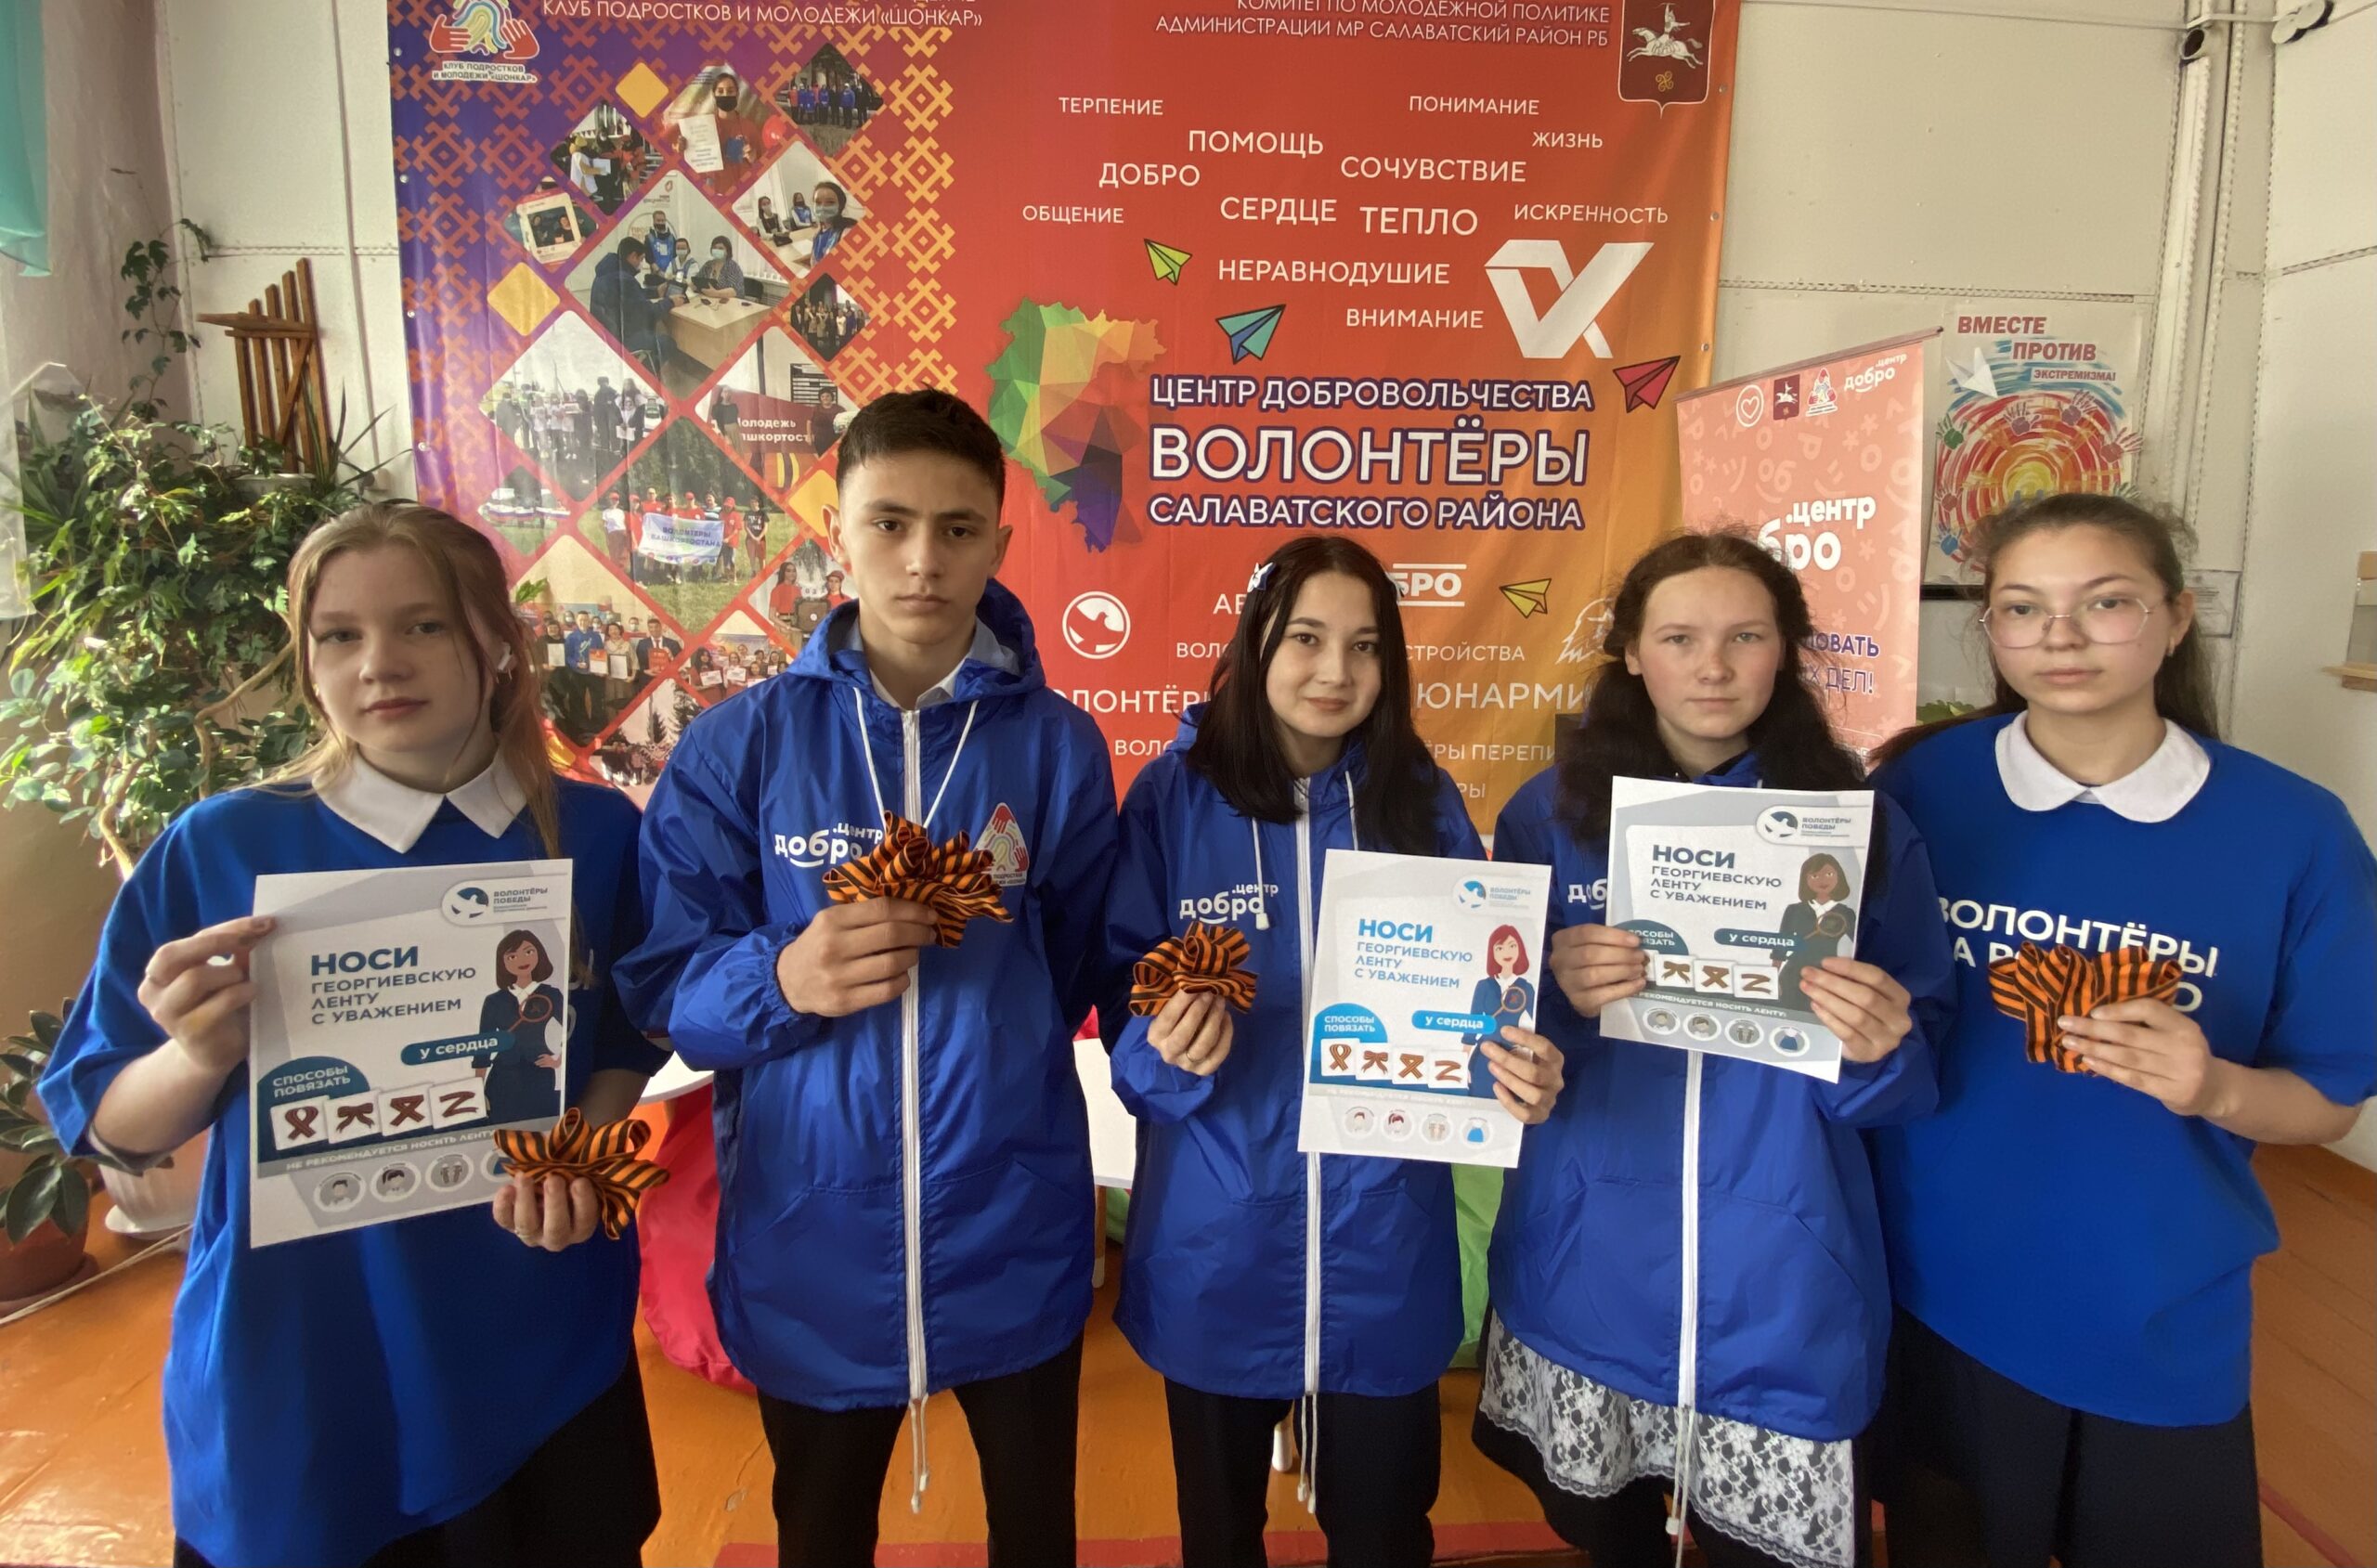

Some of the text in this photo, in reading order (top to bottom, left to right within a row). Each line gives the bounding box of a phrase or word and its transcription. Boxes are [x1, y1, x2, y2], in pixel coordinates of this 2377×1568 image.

[543, 0, 982, 26] КЛУБ ПОДРОСТКОВ И МОЛОДЕЖИ «ШОНКАР»
[1513, 4, 1610, 23] ПОЛИТИКЕ
[1155, 16, 1608, 46] АДМИНИСТРАЦИИ МР САЛАВАТСКИЙ РАЙОН РБ
[467, 63, 524, 72] ПОДРОСТКОВ
[1059, 97, 1163, 115] ТЕРПЕНИЕ
[1409, 96, 1539, 115] ПОНИМАНИЕ
[1188, 130, 1324, 159] ПОМОЩЬ
[1532, 131, 1604, 149] ЖИЗНЬ
[1098, 162, 1201, 188] ДОБРО
[1340, 156, 1527, 183] СОЧУВСТВИЕ
[1022, 205, 1124, 225] ОБЩЕНИЕ
[1219, 196, 1338, 226] СЕРДЦЕ
[1358, 205, 1479, 237] ТЕПЛО
[1513, 203, 1669, 225] ИСКРЕННОСТЬ
[1218, 259, 1450, 287] НЕРАВНОДУШИЕ
[1346, 308, 1485, 329] ВНИМАНИЕ
[1957, 315, 2047, 334] ВМЕСТЕ
[2012, 342, 2098, 361] ПРОТИВ
[1844, 366, 1896, 392] добро
[2033, 369, 2116, 382] ЭКСТРЕМИЗМА!
[1153, 378, 1593, 409] ЦЕНТР ДОБРОВОЛЬЧЕСТВА
[737, 417, 796, 430] олодежь
[1152, 417, 1587, 483] ВОЛОНТЁРЫ
[1150, 493, 1582, 527] САЛАВАТСКОГО РАЙОНА
[774, 829, 863, 864] добро
[1652, 845, 1735, 869] НОСИ
[1650, 878, 1701, 892] ЛЕНТУ
[1651, 865, 1783, 888] ГЕОРГИЕВСКУЮ
[1179, 890, 1262, 921] добро
[1650, 889, 1768, 911] С УВАЖЕНИЕМ
[1358, 918, 1434, 943] НОСИ
[1742, 933, 1795, 947] сердца
[311, 946, 419, 976] НОСИ
[1356, 956, 1402, 969] ЛЕНТУ
[1357, 941, 1473, 963] ГЕОРГИЕВСКУЮ
[311, 967, 476, 994] ГЕОРГИЕВСКУЮ
[1355, 968, 1460, 989] С УВАЖЕНИЕМ
[311, 992, 380, 1011] ЛЕНТУ
[311, 998, 461, 1025] С УВАЖЕНИЕМ
[1715, 1002, 1752, 1013] НОСИТЬ
[1324, 1015, 1375, 1025] СПОСОБЫ
[1324, 1023, 1376, 1033] ПОВЯЗАТЬ
[1436, 1016, 1484, 1030] сердца
[435, 1036, 499, 1056] сердца
[272, 1065, 348, 1088] СПОСОБЫ
[273, 1075, 351, 1099] ПОВЯЗАТЬ
[286, 1160, 304, 1171] НЕ
[305, 1143, 408, 1167] РЕКОМЕНДУЕТСЯ
[410, 1135, 457, 1150] НОСИТЬ
